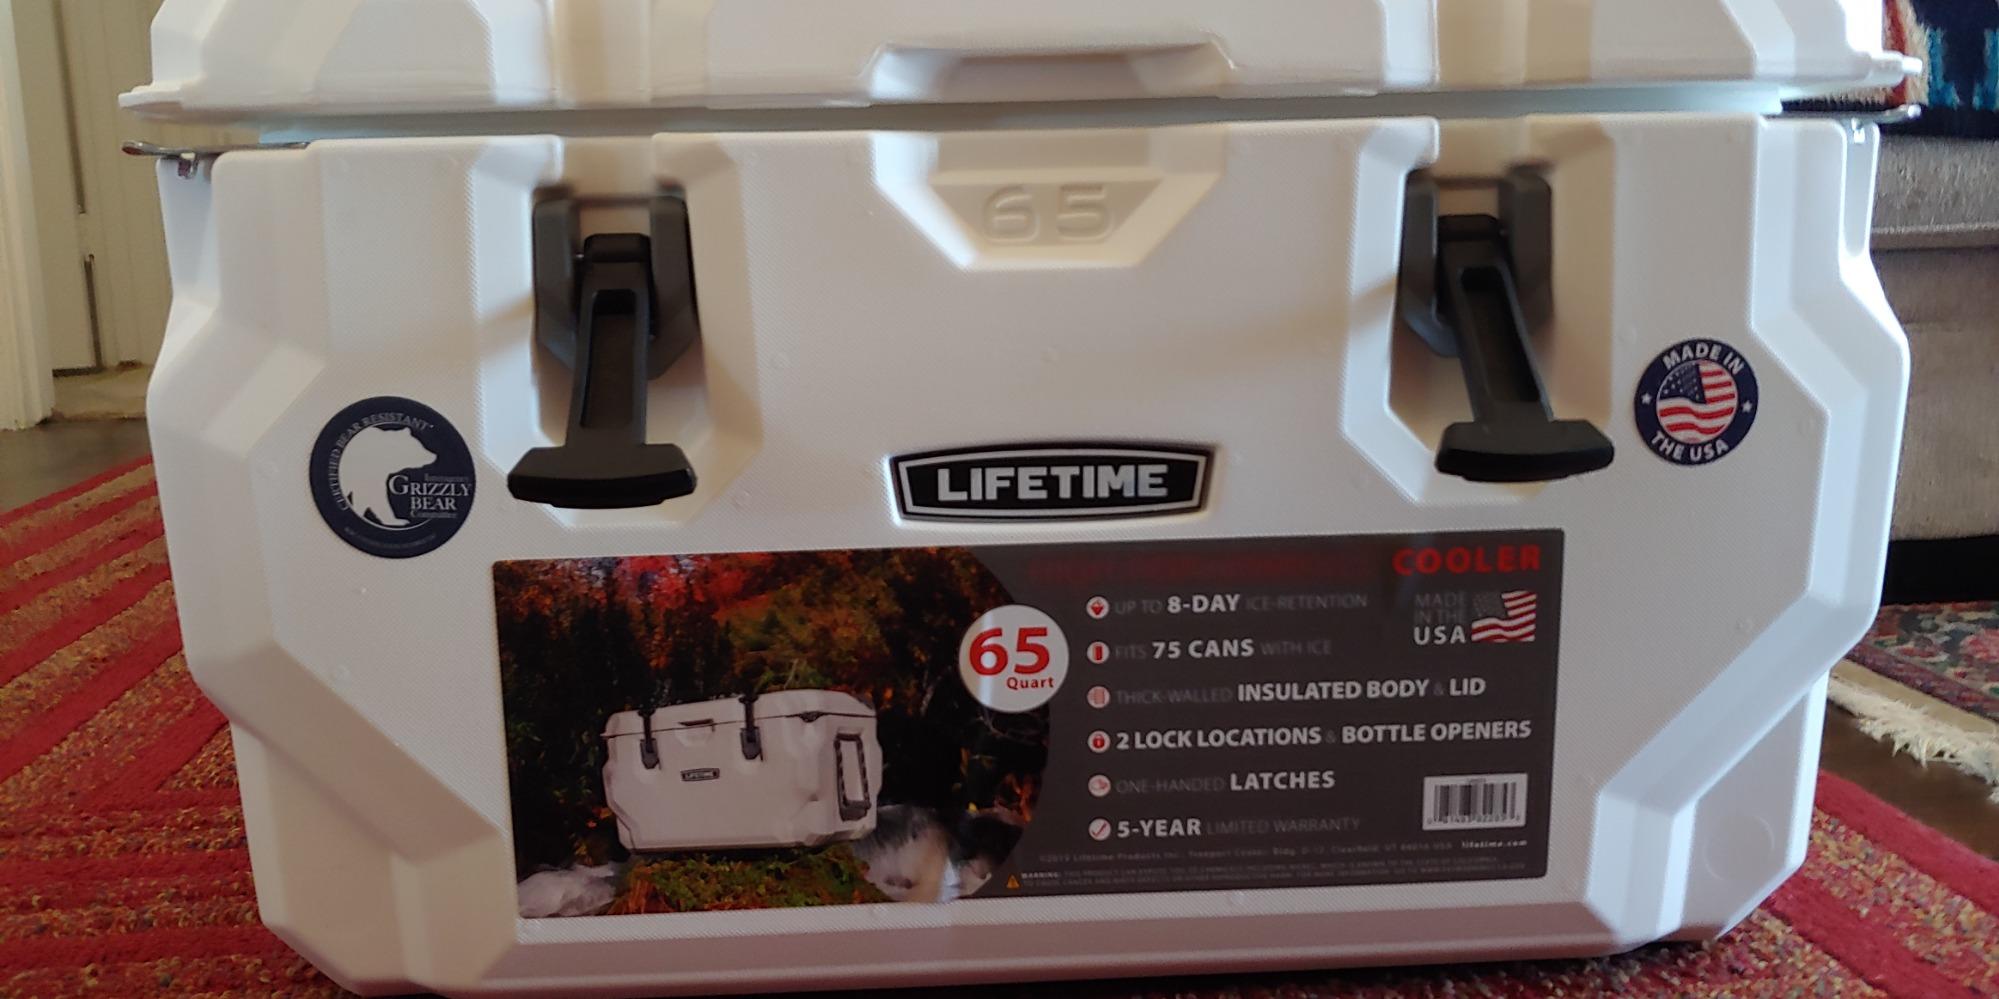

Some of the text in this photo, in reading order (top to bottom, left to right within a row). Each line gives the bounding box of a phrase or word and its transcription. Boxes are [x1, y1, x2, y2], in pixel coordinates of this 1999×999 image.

[983, 184, 1113, 243] 65
[1662, 342, 1744, 375] MADE IN
[336, 421, 362, 448] BEAR
[1651, 430, 1729, 461] THE USA
[328, 448, 349, 511] CERTIFIED
[389, 474, 470, 496] GRIZZLY
[937, 464, 1168, 502] LIFETIME
[411, 496, 457, 510] BEAR
[1392, 544, 1541, 576] COOLER
[1114, 600, 1136, 615] UP
[1141, 599, 1162, 614] TO
[1166, 593, 1241, 614] 8-DAY
[1414, 591, 1468, 608] MADE
[1414, 608, 1468, 624] IN THE
[1414, 625, 1467, 645] USA
[968, 625, 1052, 677] 65
[1115, 638, 1332, 660] FITS 75 CANS WITH ICE
[1006, 675, 1054, 692] Quart
[1116, 687, 1233, 705] THICK-WALLED
[1237, 680, 1362, 702] INSULATED
[1366, 678, 1430, 699] BODY
[1449, 677, 1487, 696] LID
[1116, 732, 1130, 750] 2
[1134, 729, 1193, 749] LOCK
[1196, 726, 1322, 748] LOCATIONS
[1341, 723, 1427, 744] BOTTLE
[1430, 720, 1533, 741] OPENERS
[1115, 770, 1336, 795] ONE-HANDED LATCHES
[1117, 816, 1361, 839] 5-YEAR LIMITED WARRANTY
